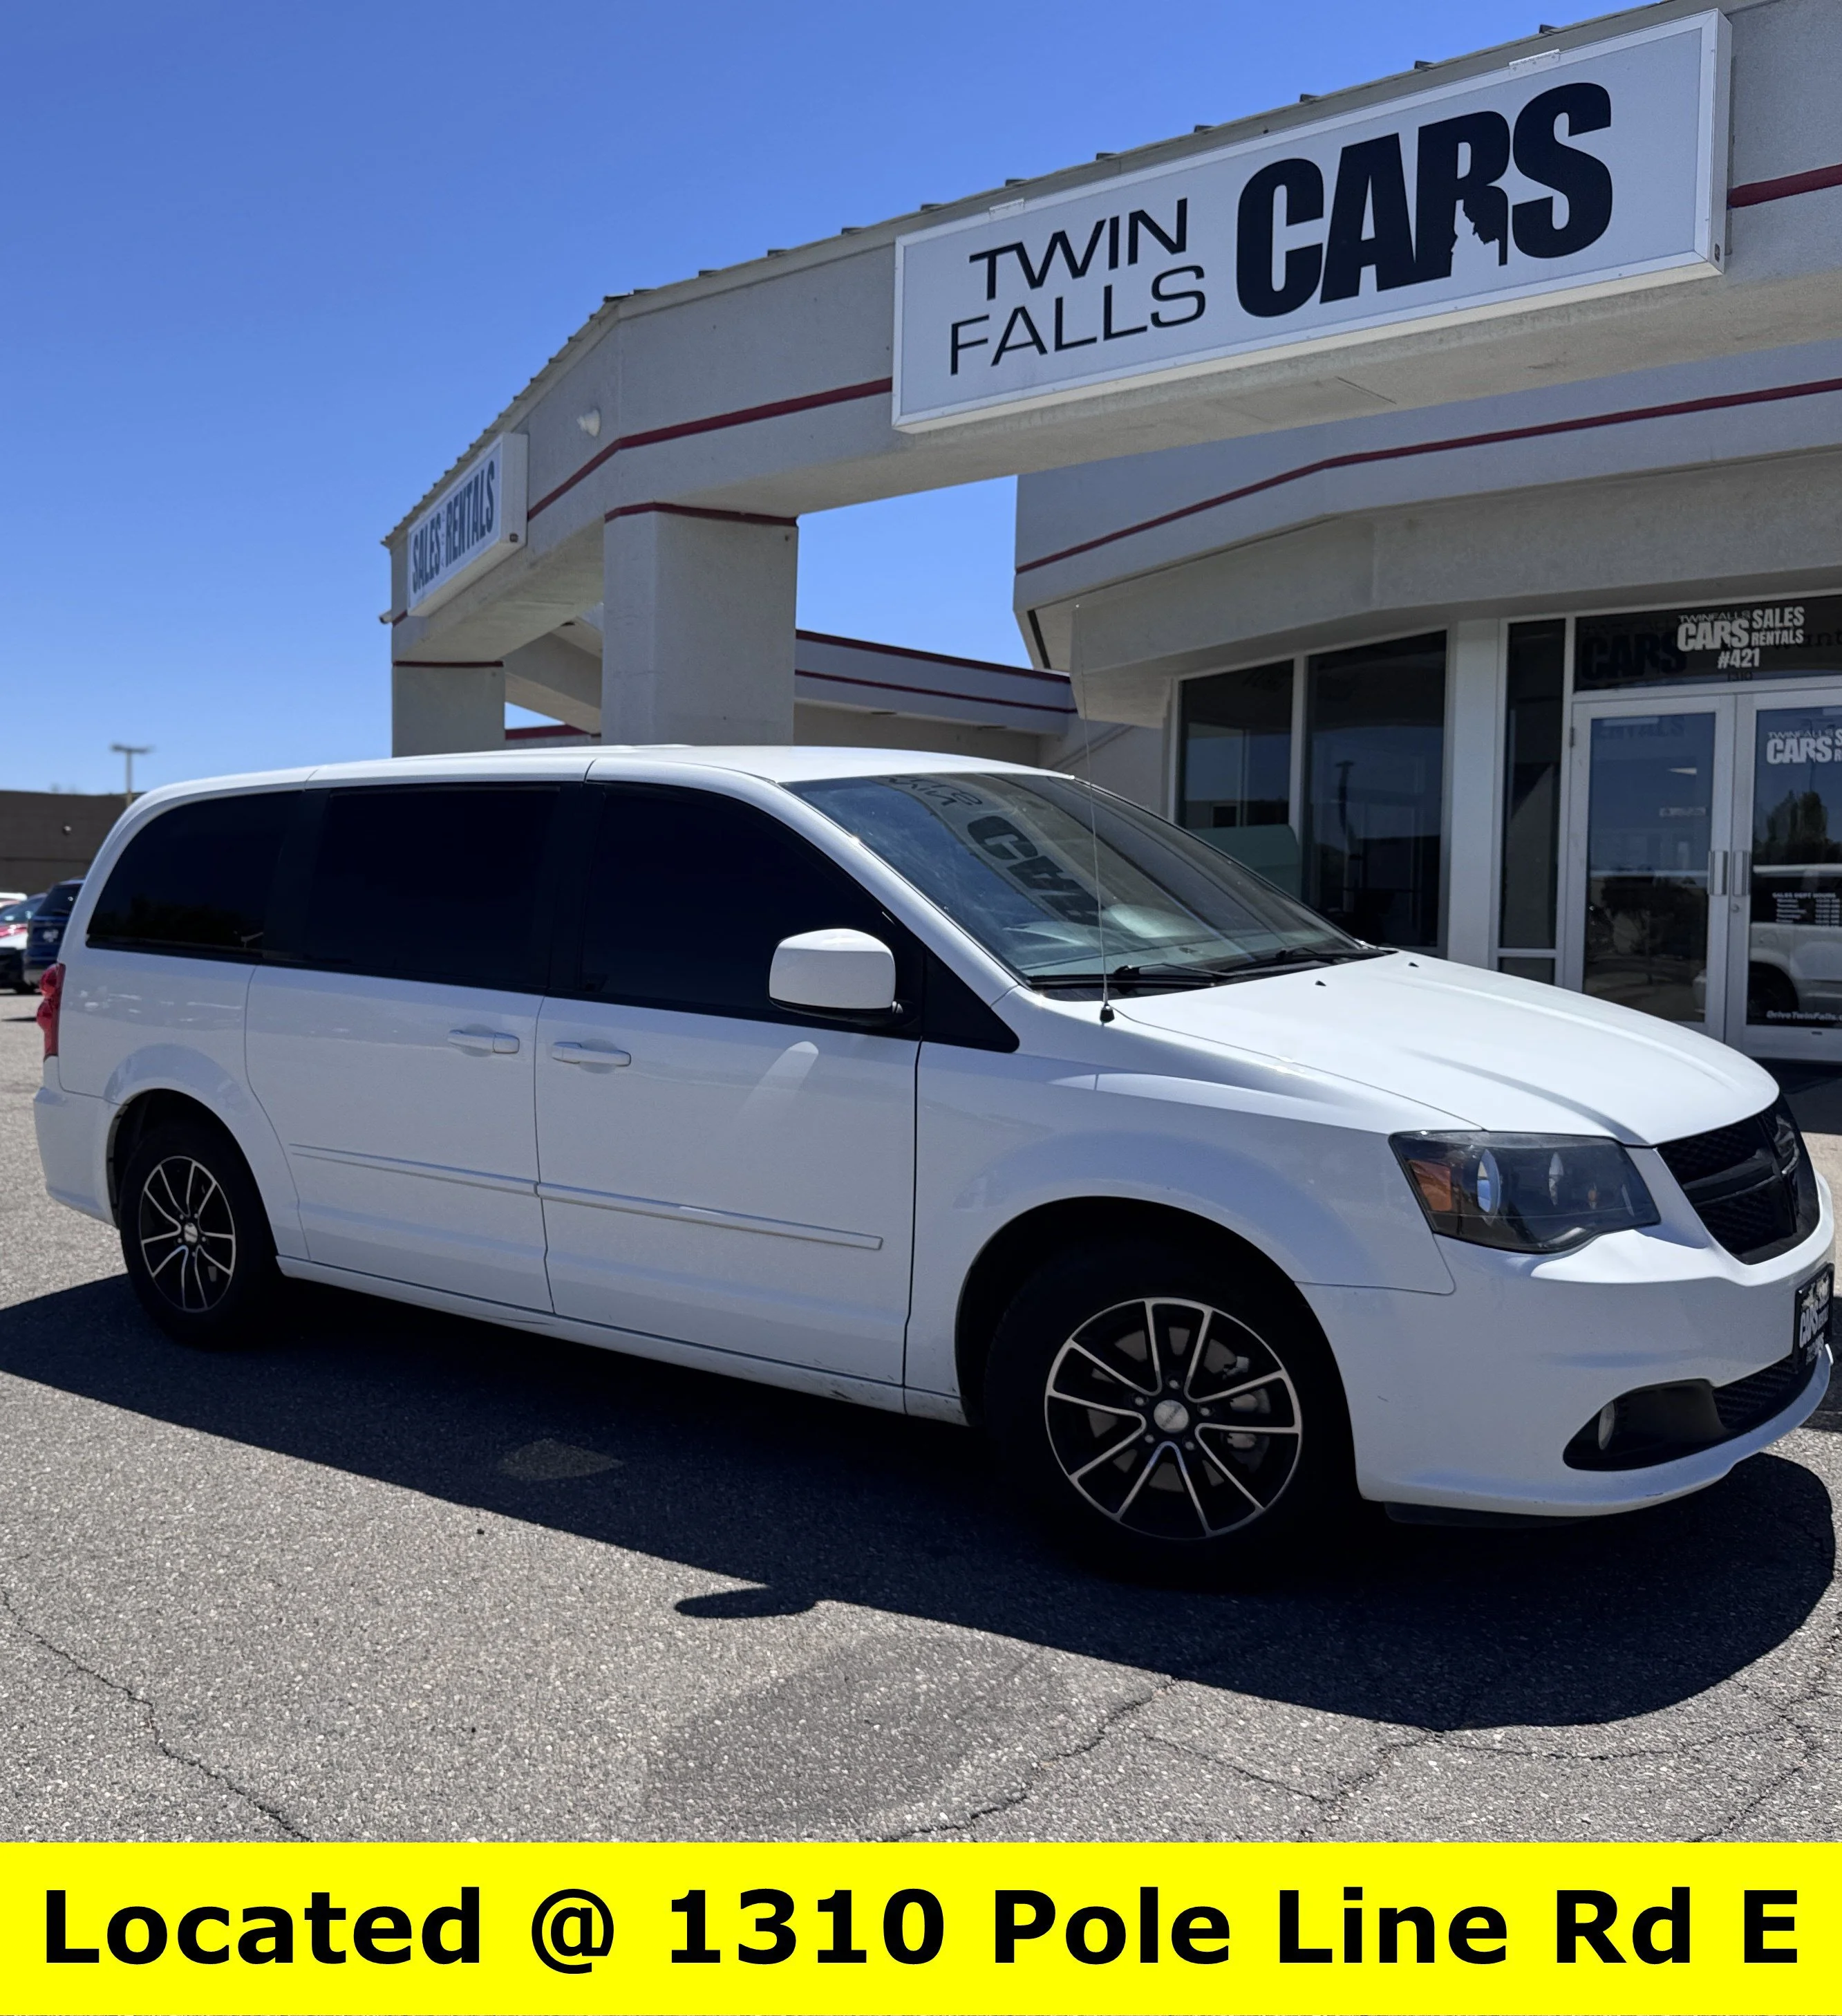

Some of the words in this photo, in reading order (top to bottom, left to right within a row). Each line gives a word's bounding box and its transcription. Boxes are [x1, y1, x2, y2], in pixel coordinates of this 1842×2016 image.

[1237, 83, 1613, 317] CARS
[969, 198, 1187, 300] TWIN
[951, 265, 1205, 375] FALLS
[413, 513, 441, 593] SALES
[446, 460, 495, 568] RENTALS
[1751, 606, 1805, 629] SALES
[1677, 618, 1749, 652] CARS
[1751, 628, 1804, 646] RENTALS
[1717, 647, 1760, 669] #421
[1767, 736, 1833, 764] CARS
